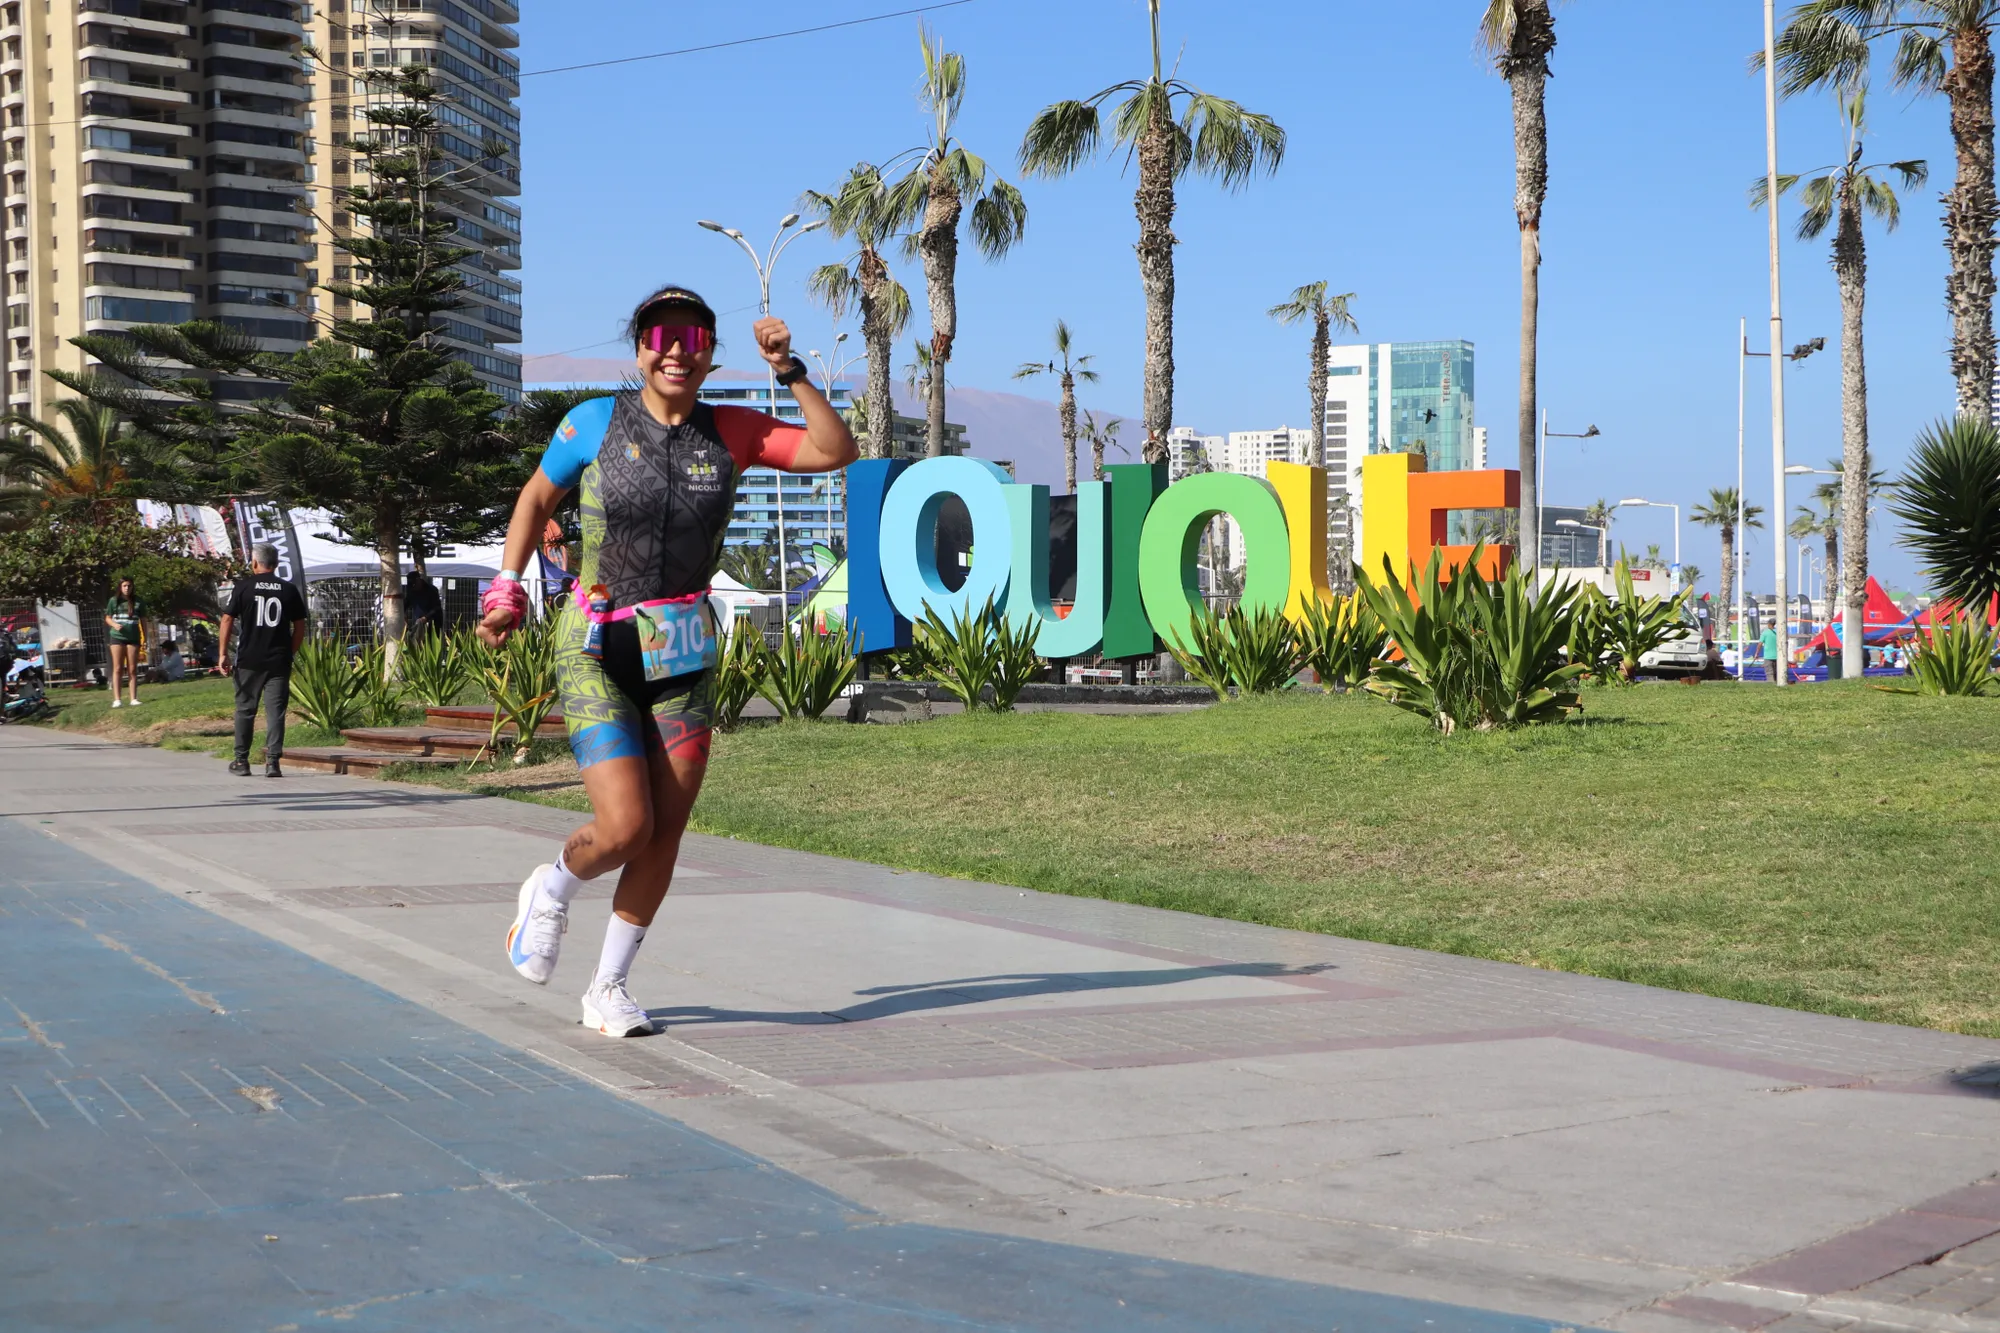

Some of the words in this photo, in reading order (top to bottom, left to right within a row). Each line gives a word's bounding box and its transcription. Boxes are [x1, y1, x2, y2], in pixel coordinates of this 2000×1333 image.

[255, 582, 282, 591] ASSADI
[847, 452, 1520, 686] IQUIQUE
[255, 595, 282, 627] 10
[658, 615, 705, 660] 210
